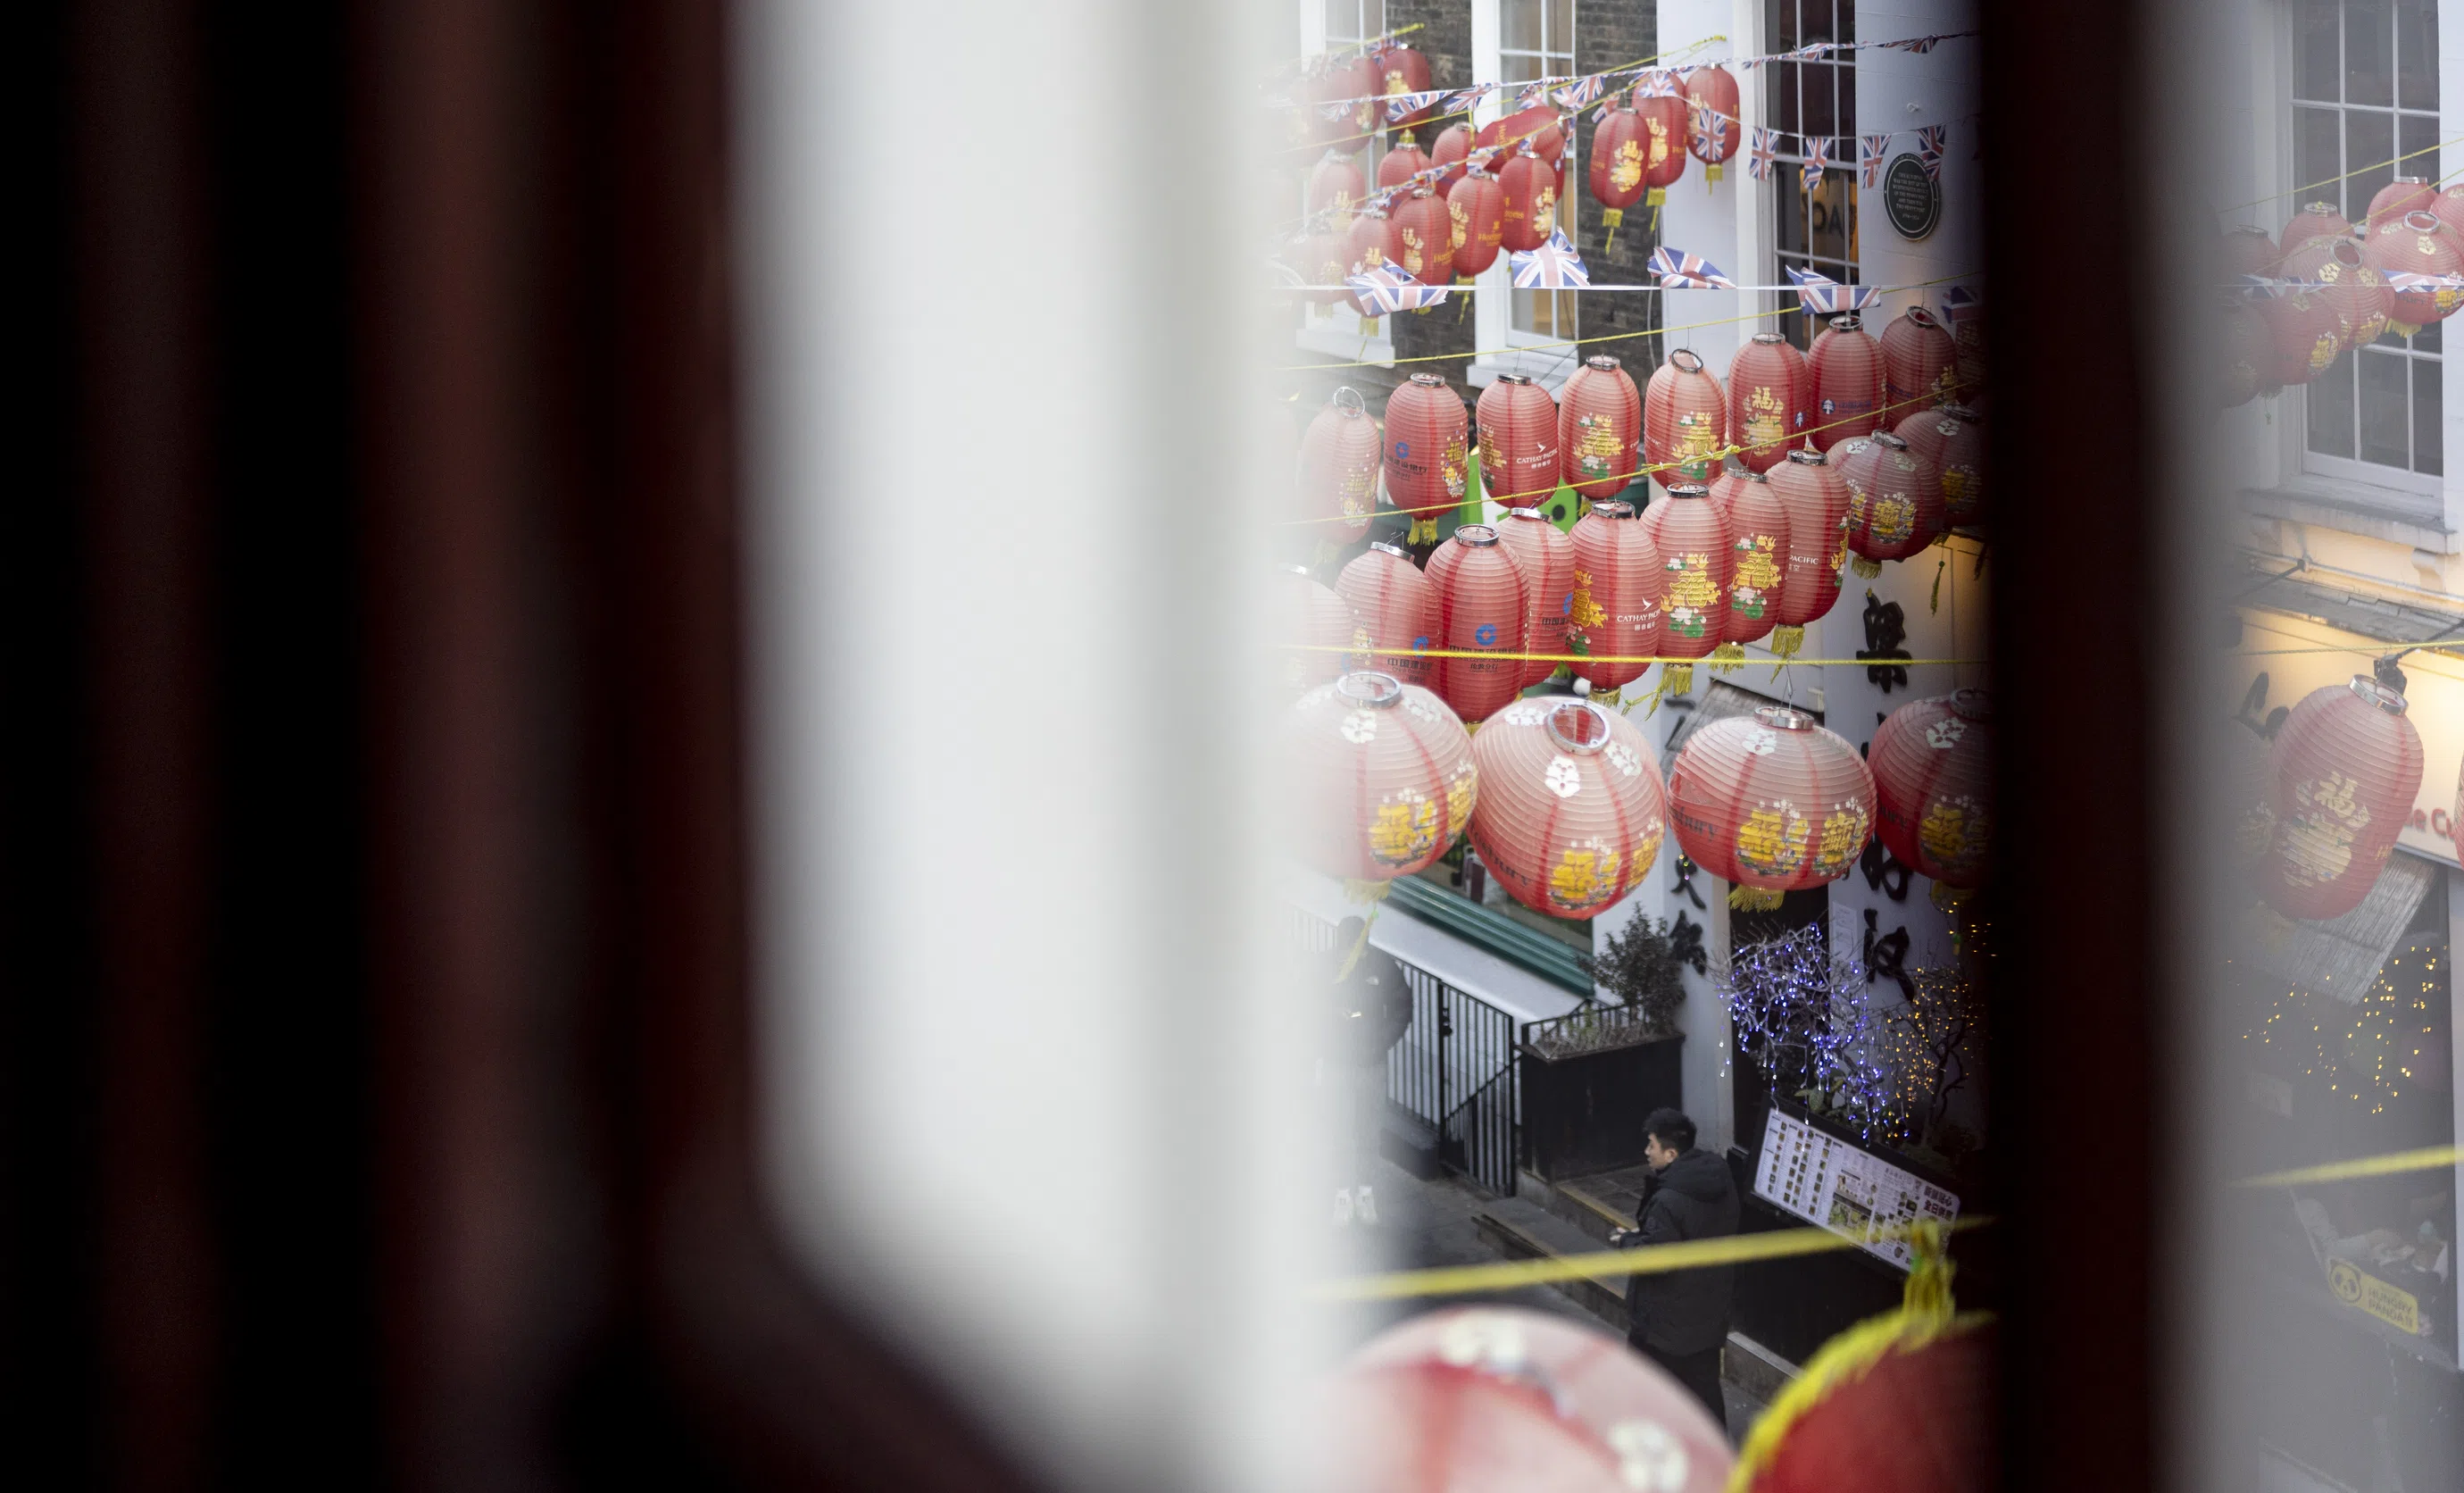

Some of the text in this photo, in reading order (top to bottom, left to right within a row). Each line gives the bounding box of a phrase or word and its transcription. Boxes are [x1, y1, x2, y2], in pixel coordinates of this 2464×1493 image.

[1751, 386, 1775, 411] 福
[1516, 454, 1543, 464] CATHAY
[1617, 613, 1647, 623] CATHAY
